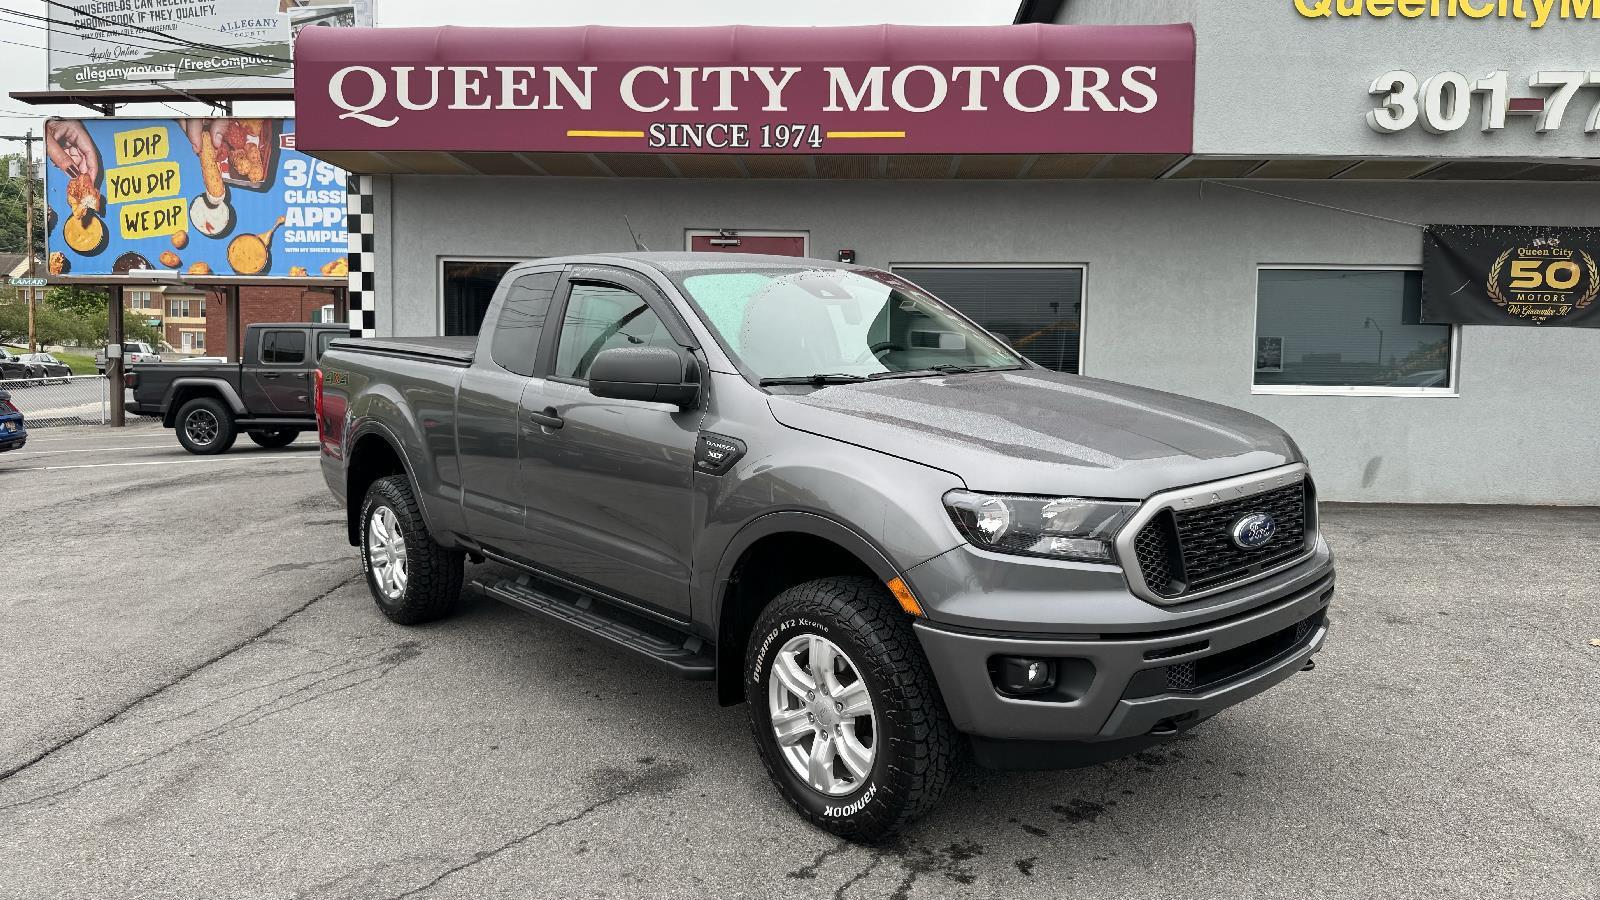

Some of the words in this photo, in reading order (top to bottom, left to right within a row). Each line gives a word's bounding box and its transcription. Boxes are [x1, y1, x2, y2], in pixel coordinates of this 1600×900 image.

[73, 0, 131, 16] HOUSEHOLDS
[138, 11, 146, 23] IF
[149, 9, 173, 21] THEY
[176, 4, 217, 20] QUALIFY.
[220, 18, 278, 32] ALLEGANY
[114, 45, 140, 59] Online
[328, 65, 599, 128] QUEEN
[619, 65, 802, 113] CITY
[822, 64, 1159, 113] MOTORS
[1366, 69, 1600, 134] 301-7
[124, 139, 128, 157] I
[133, 133, 162, 157] DIP
[648, 122, 750, 149] SINCE
[760, 123, 823, 149] 1974
[111, 175, 141, 198] YOU
[147, 169, 175, 194] DIP
[125, 210, 150, 232] WE
[154, 205, 182, 230] DIP
[284, 229, 348, 243] SAMPLE
[1517, 247, 1550, 257] Queen
[1552, 247, 1574, 258] City
[1509, 260, 1581, 290] 50
[1516, 294, 1566, 302] MOTORS
[1248, 521, 1271, 542] Ford
[780, 619, 796, 632] AT2
[798, 617, 829, 633] Xtreme
